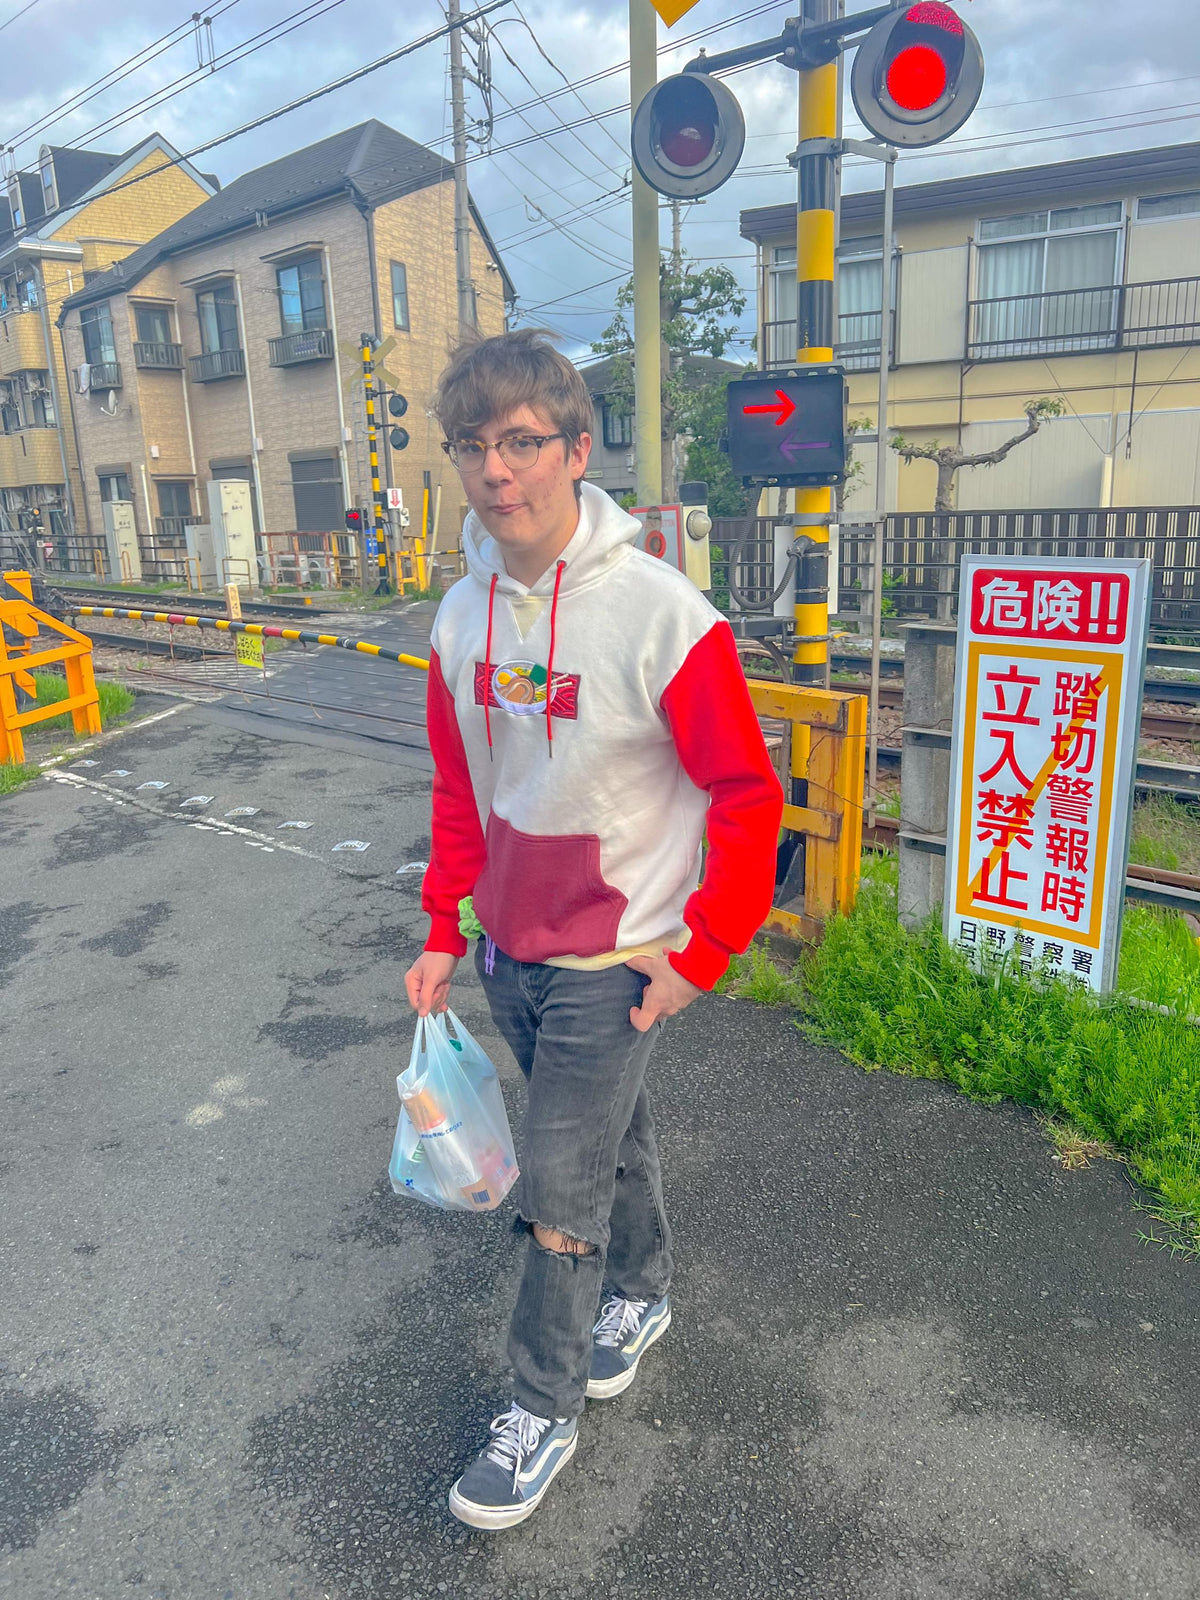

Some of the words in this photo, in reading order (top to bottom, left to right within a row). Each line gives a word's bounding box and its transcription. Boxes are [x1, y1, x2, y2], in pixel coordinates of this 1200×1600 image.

[979, 577, 1121, 635] 危険!!
[972, 664, 1041, 911] 立入禁止
[1041, 671, 1103, 923] 踏切警報時
[960, 920, 1093, 975] 日野警察署
